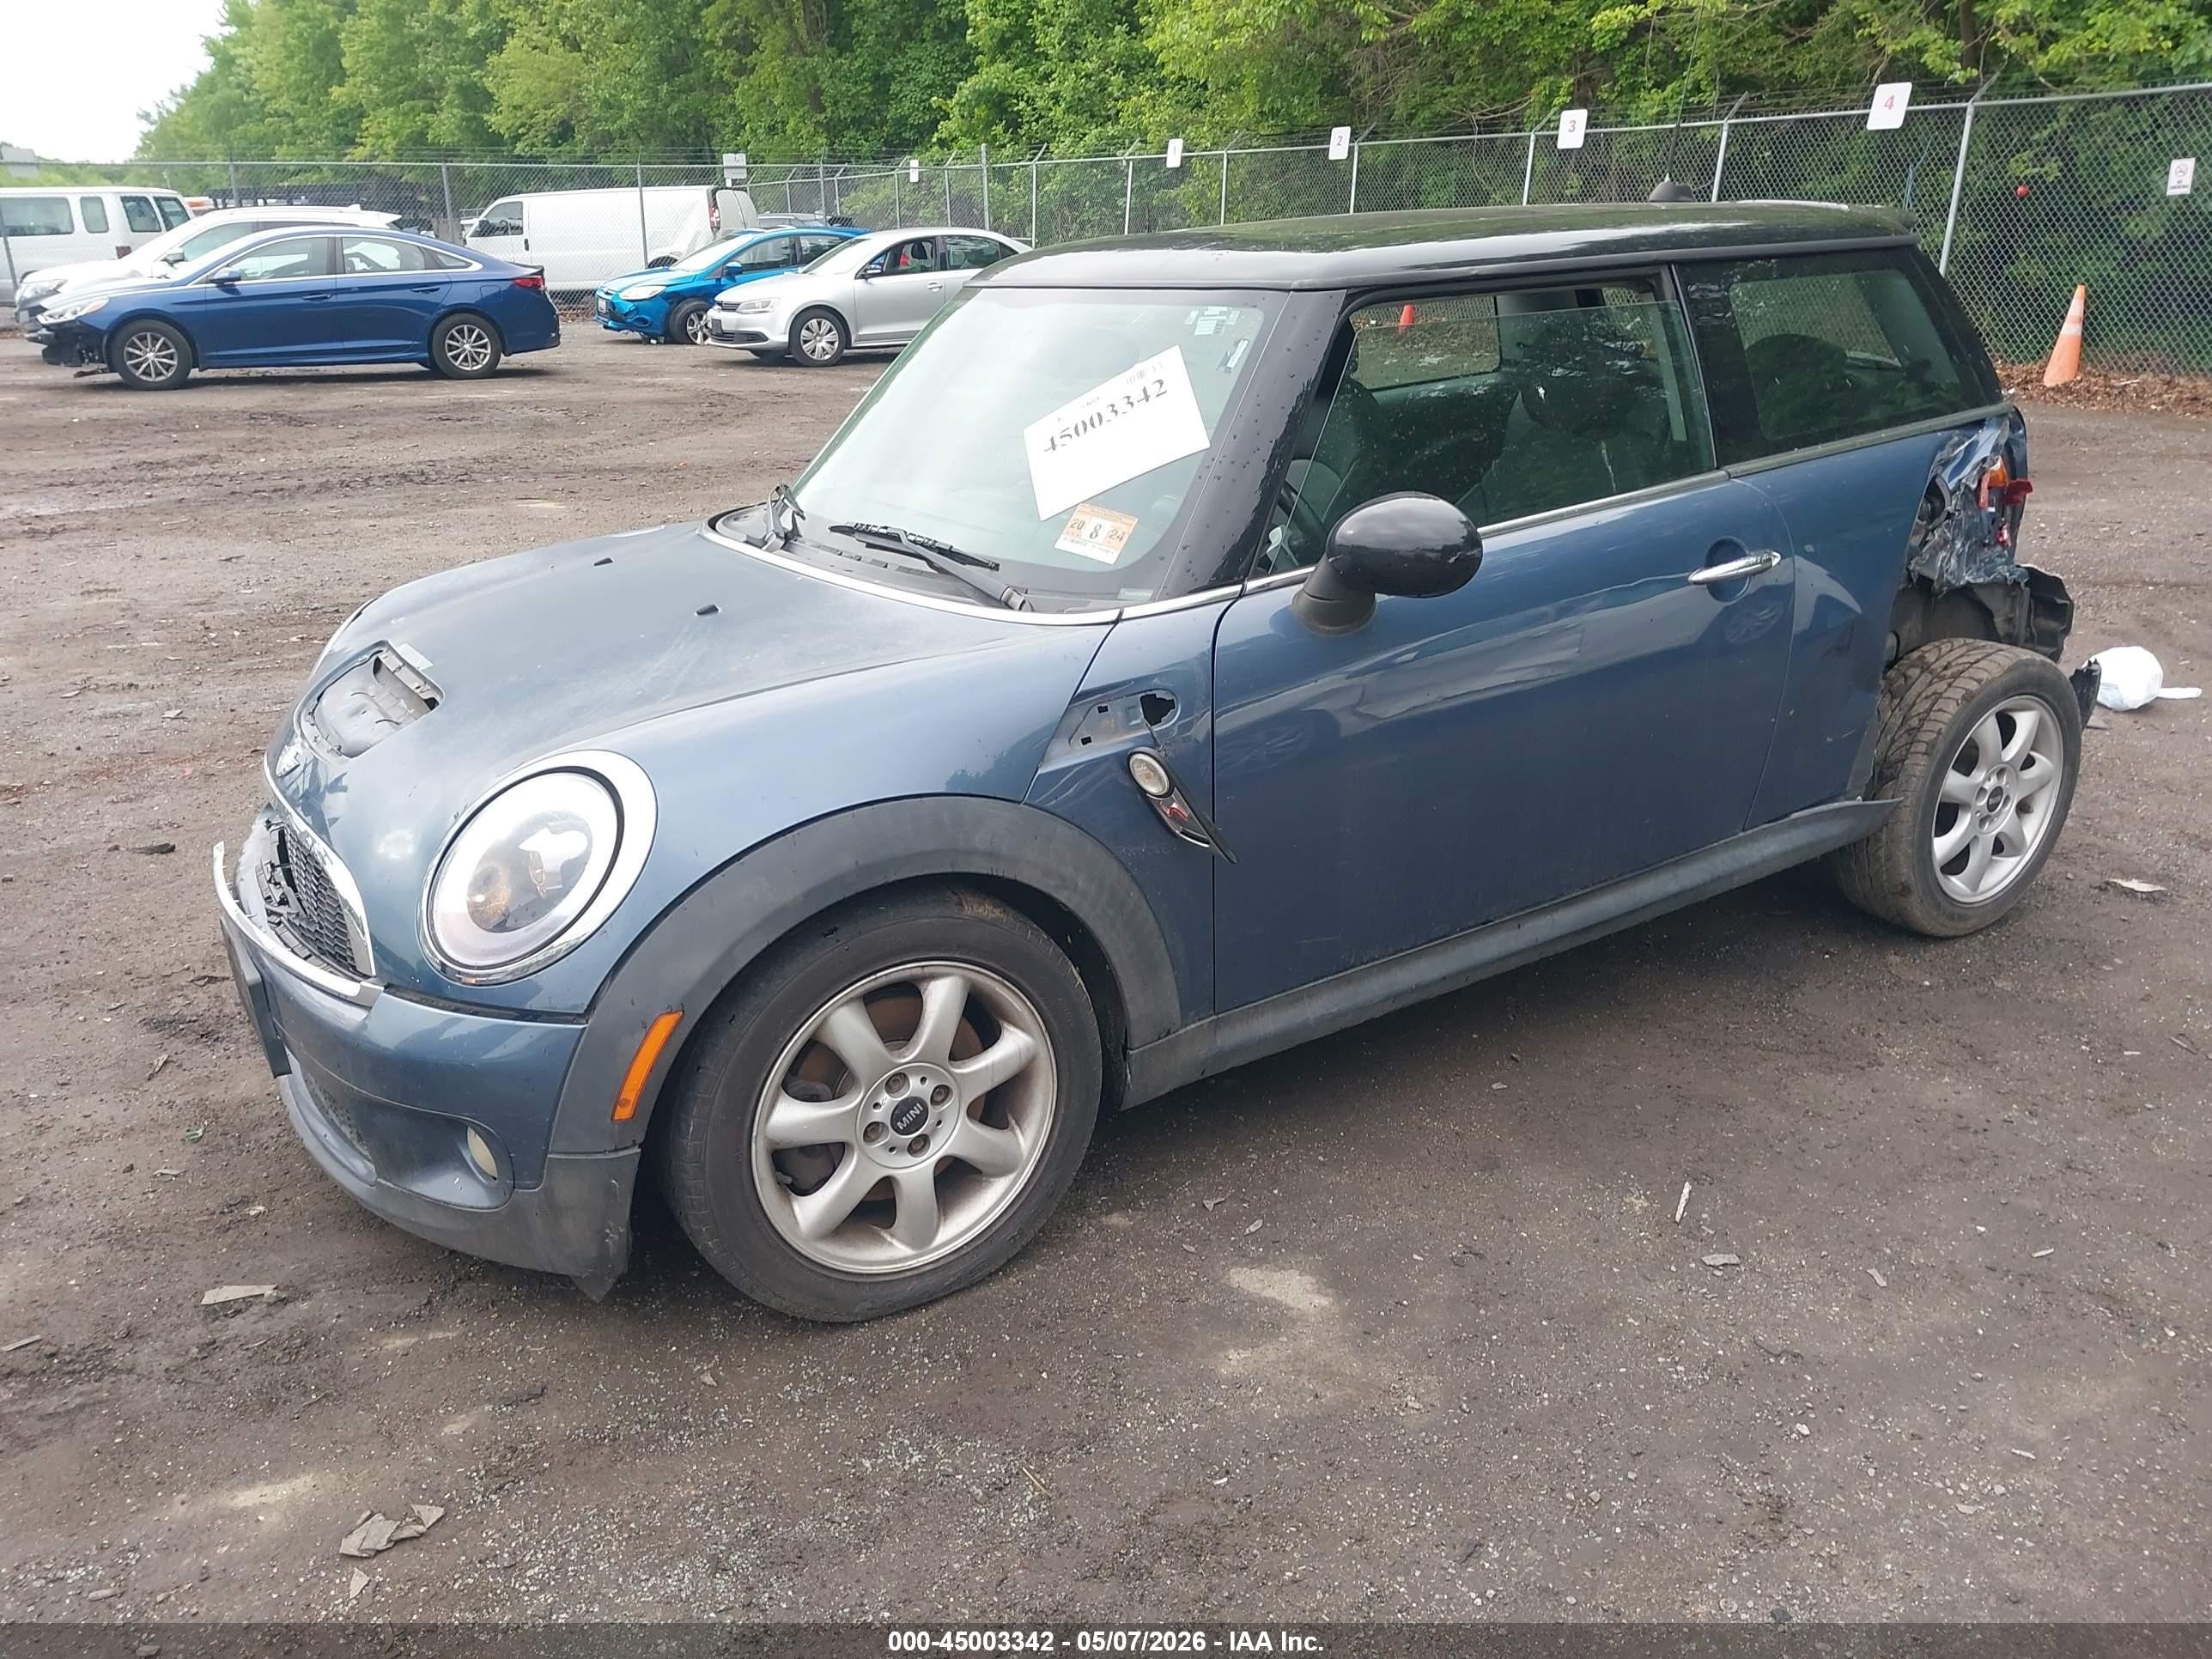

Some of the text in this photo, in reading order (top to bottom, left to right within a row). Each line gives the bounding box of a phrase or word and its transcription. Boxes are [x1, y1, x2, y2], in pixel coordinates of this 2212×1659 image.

[1883, 94, 1894, 110] 4
[1568, 119, 1577, 133] 3
[1336, 135, 1343, 146] 2
[1044, 379, 1168, 452] 45003342
[1070, 518, 1127, 542] 20 8 24
[896, 1103, 924, 1130] MINI
